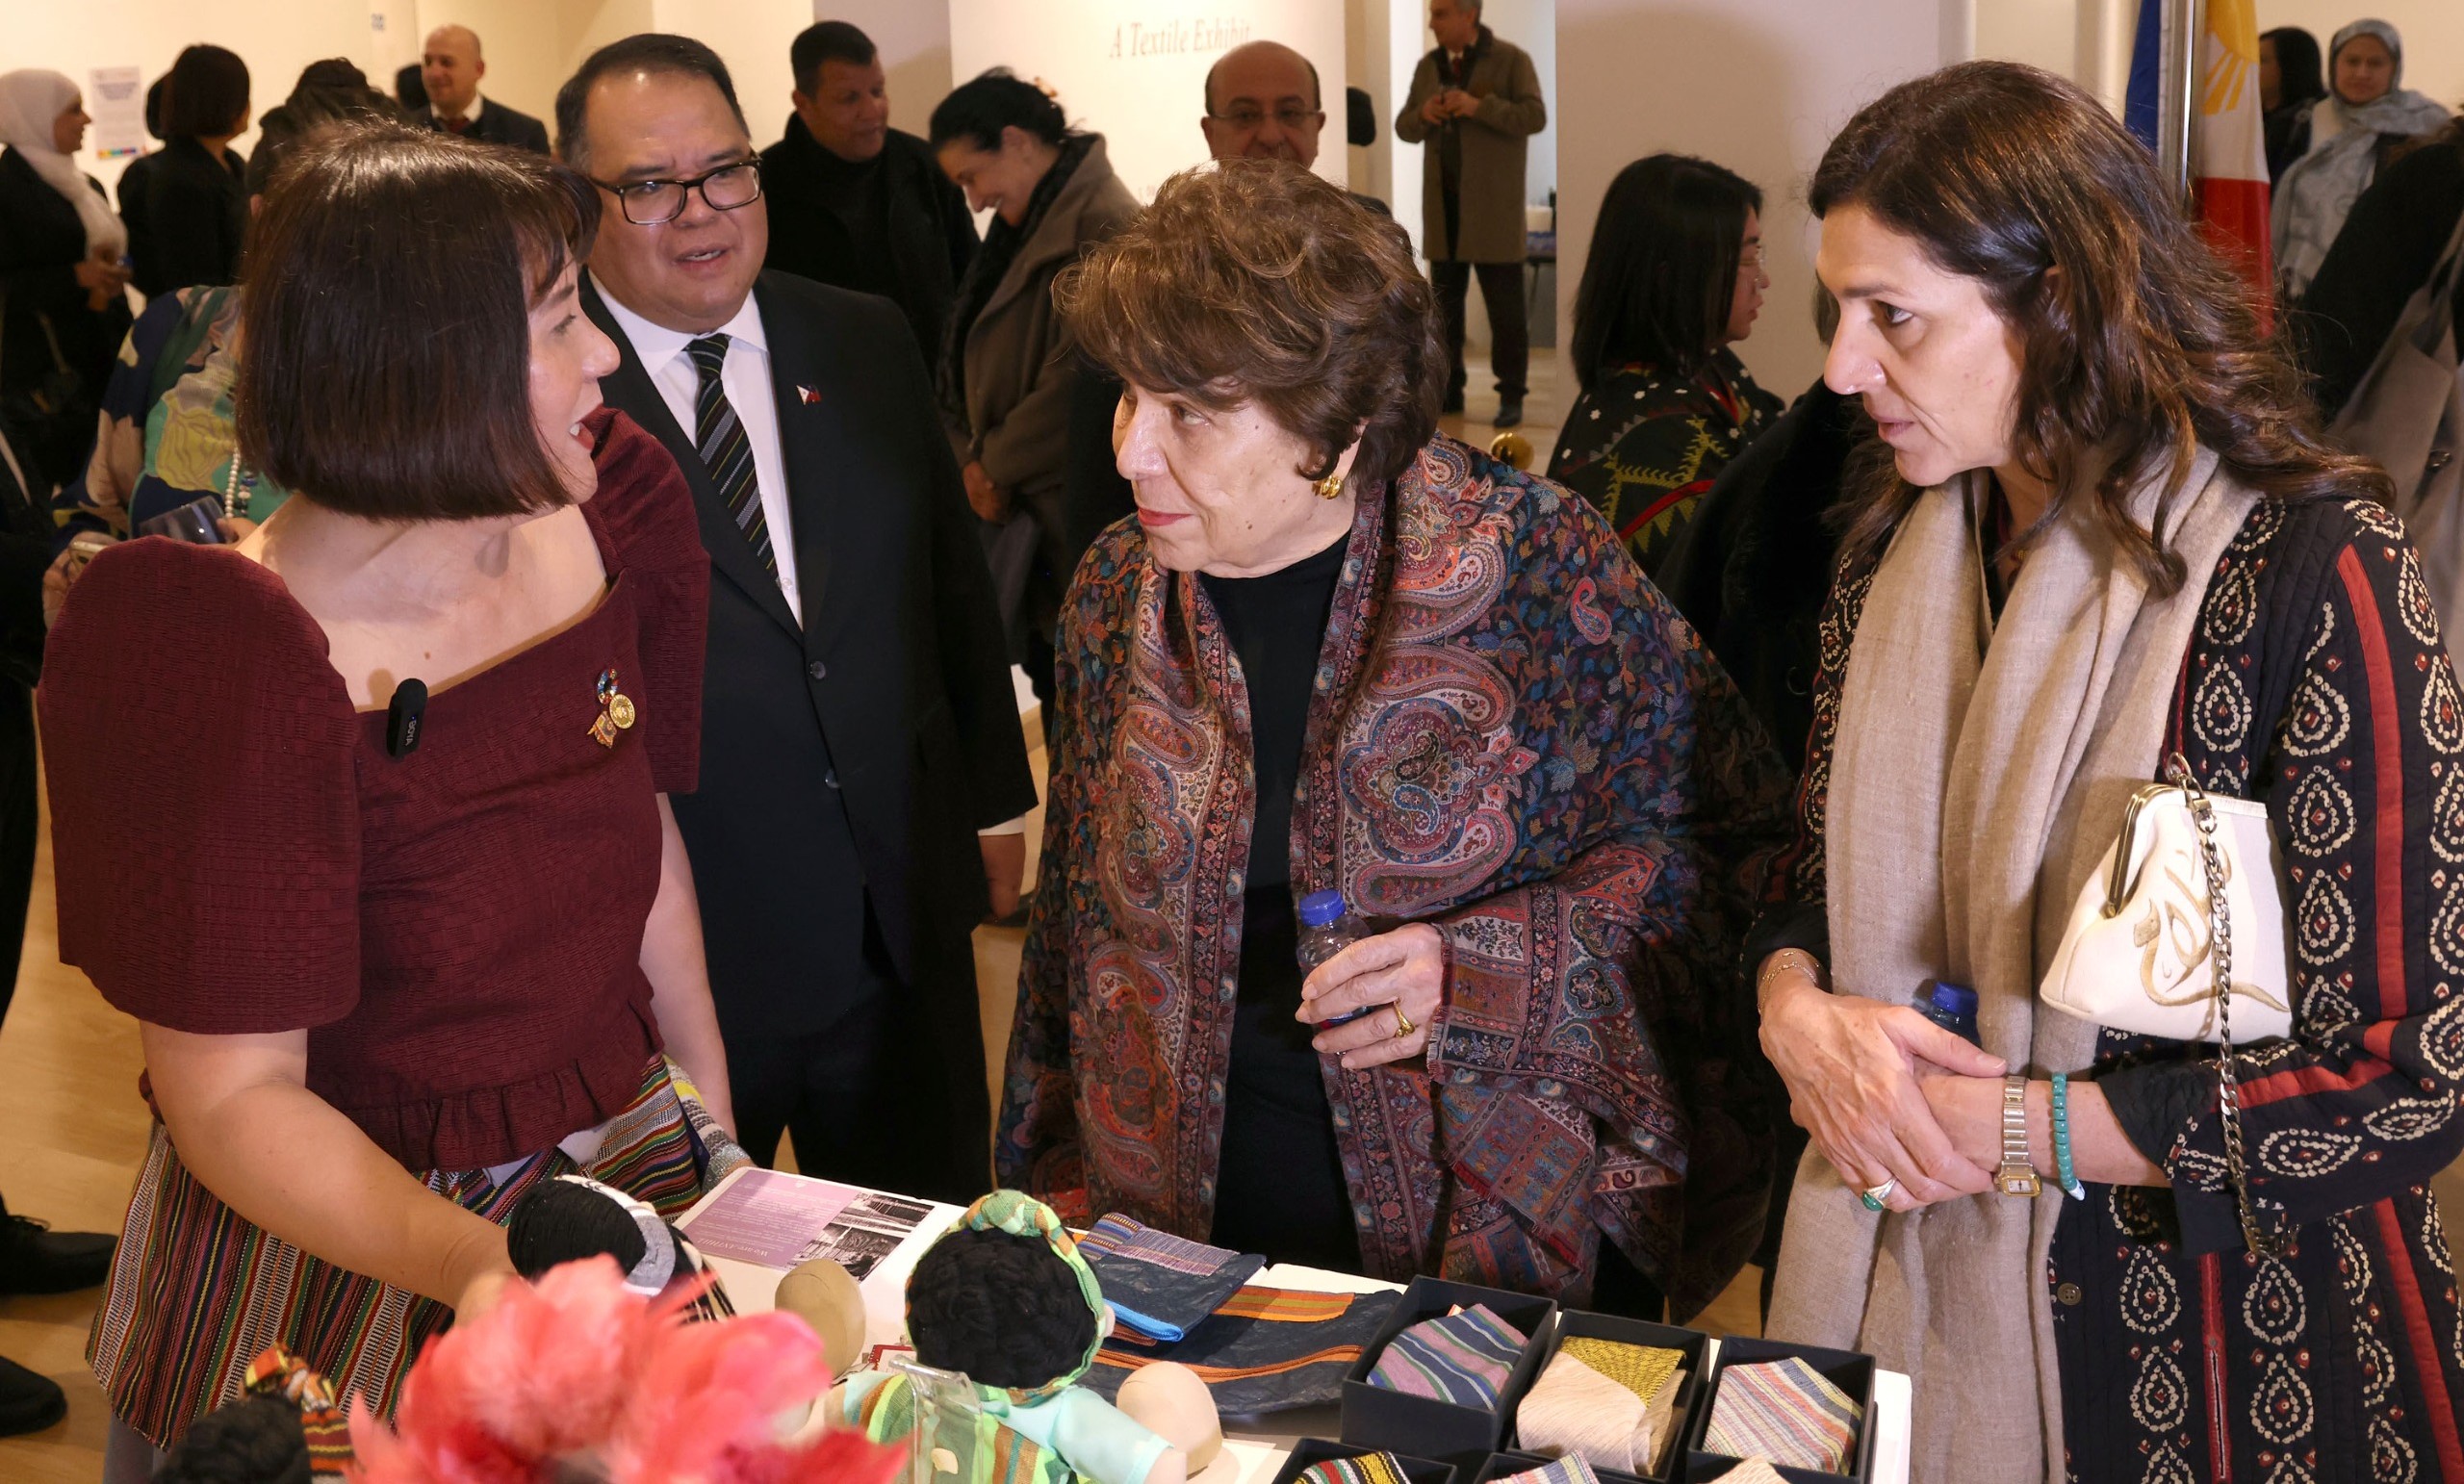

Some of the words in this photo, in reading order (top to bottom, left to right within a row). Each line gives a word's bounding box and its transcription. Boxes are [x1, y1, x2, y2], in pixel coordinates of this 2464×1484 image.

[1109, 24, 1121, 58] A
[1130, 19, 1188, 56] Textile
[1193, 17, 1250, 50] Exhibit
[405, 720, 417, 746] BOYA
